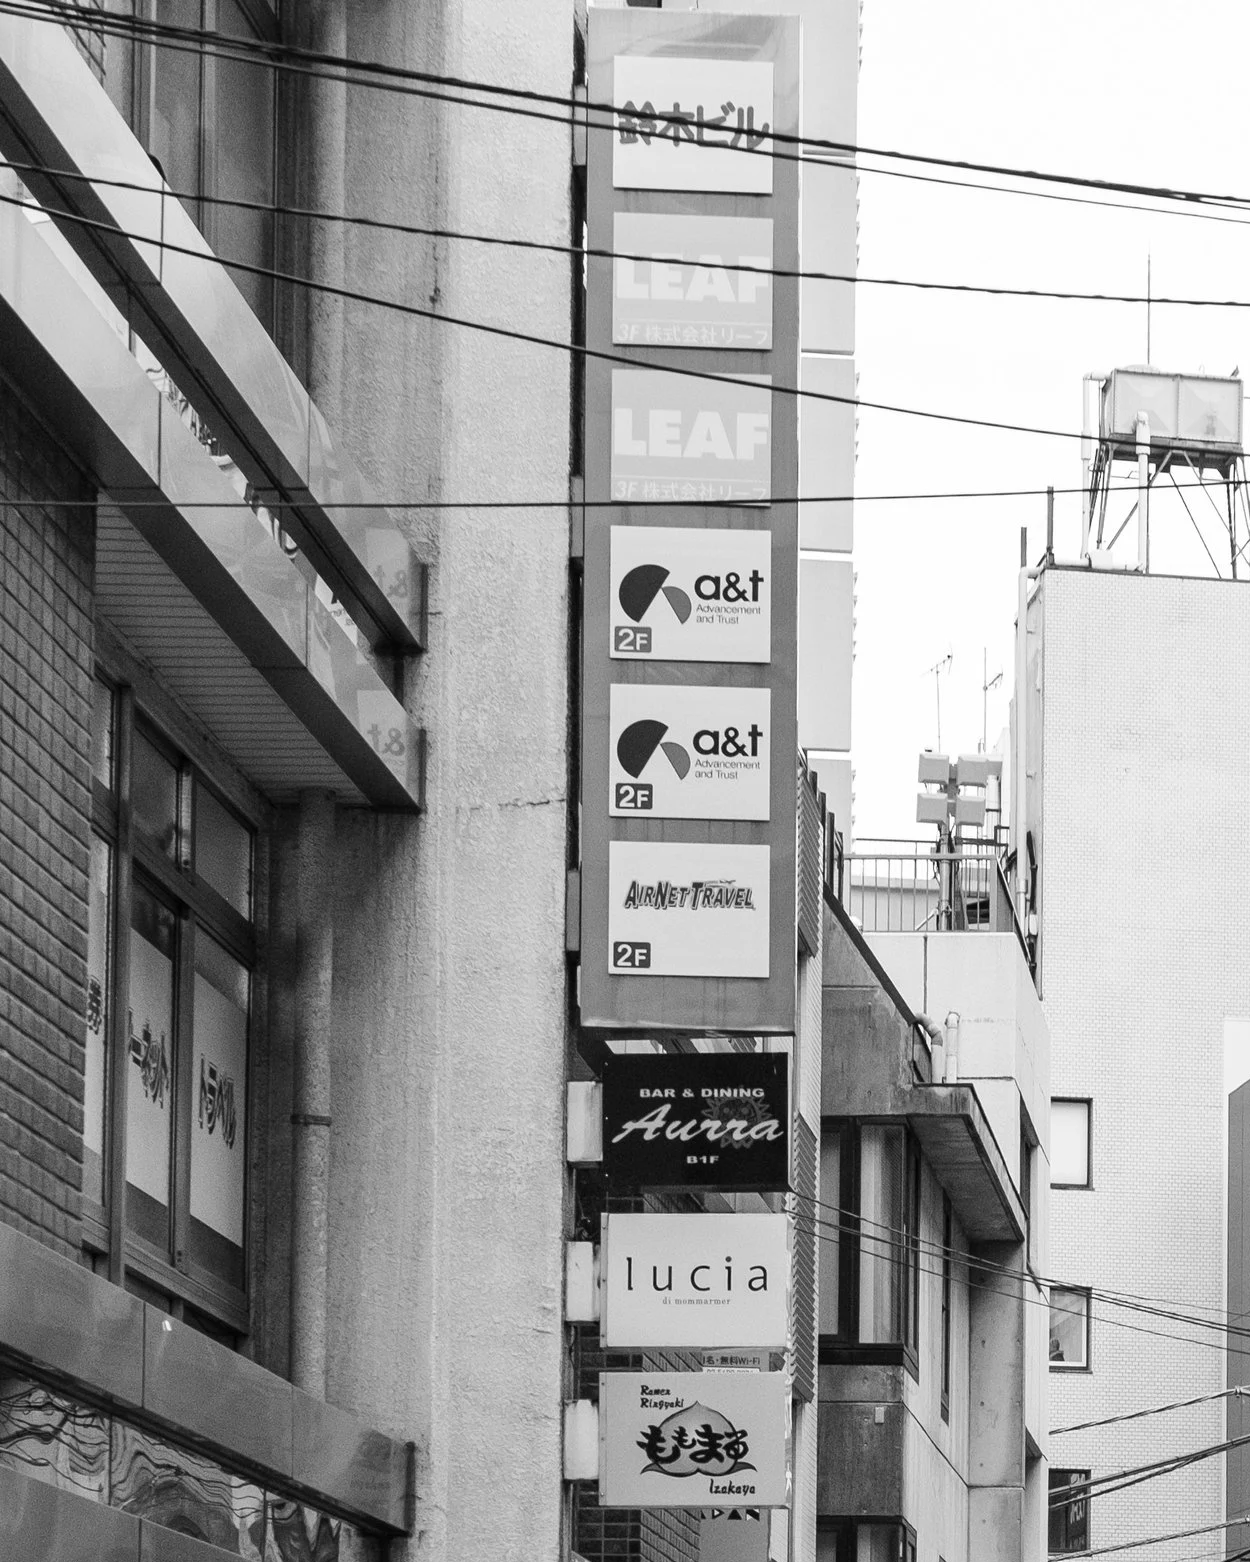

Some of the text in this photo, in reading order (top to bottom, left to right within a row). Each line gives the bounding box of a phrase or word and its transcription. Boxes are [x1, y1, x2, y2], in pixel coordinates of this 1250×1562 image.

[617, 100, 769, 150] 鈴木ビル
[614, 252, 770, 304] LEAF
[616, 324, 769, 345] 3F 株式会社リーフ
[614, 408, 769, 460] LEAF
[694, 570, 764, 602] a&t
[696, 604, 761, 615] Advancement
[696, 614, 740, 625] and Trust
[618, 629, 649, 652] 2F
[693, 724, 764, 757] a&t
[695, 758, 761, 771] Advancement
[695, 769, 739, 780] and Trust
[618, 785, 650, 808] 2F
[616, 943, 648, 967] 2F
[639, 1087, 765, 1098] BAR & DINING
[686, 1155, 719, 1165] B1F
[626, 1256, 769, 1291] lucia
